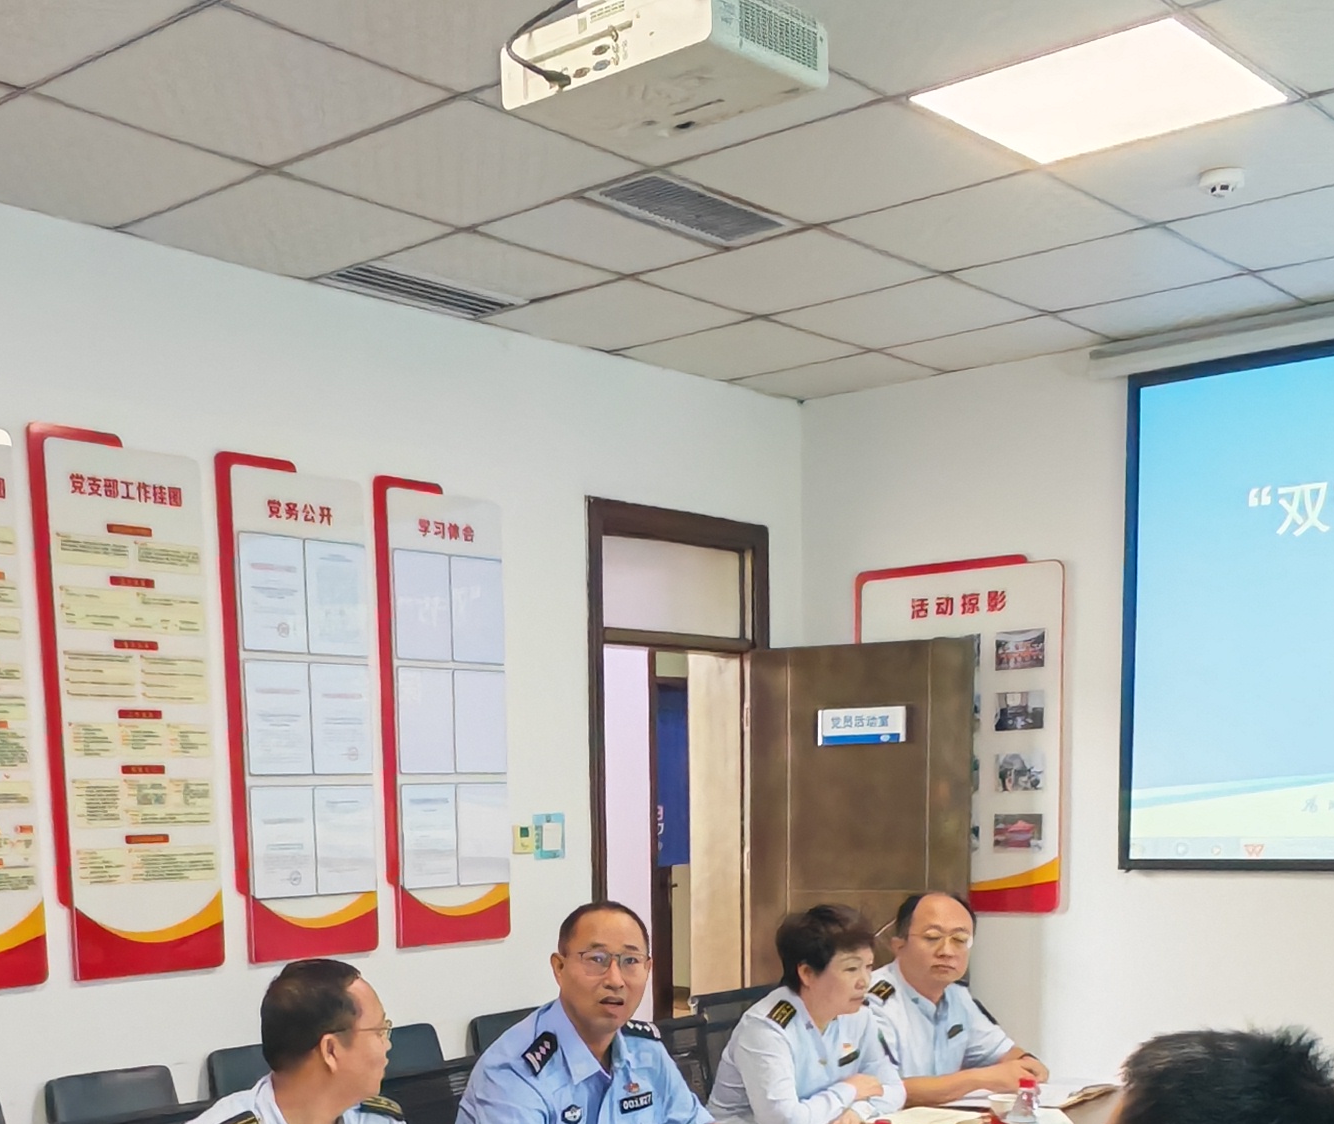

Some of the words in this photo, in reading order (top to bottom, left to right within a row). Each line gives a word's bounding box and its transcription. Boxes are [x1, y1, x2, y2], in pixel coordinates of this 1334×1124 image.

[69, 473, 183, 507] 党支部工作挂图
[267, 499, 334, 526] 党务公开
[910, 589, 1008, 620] 活动掠影
